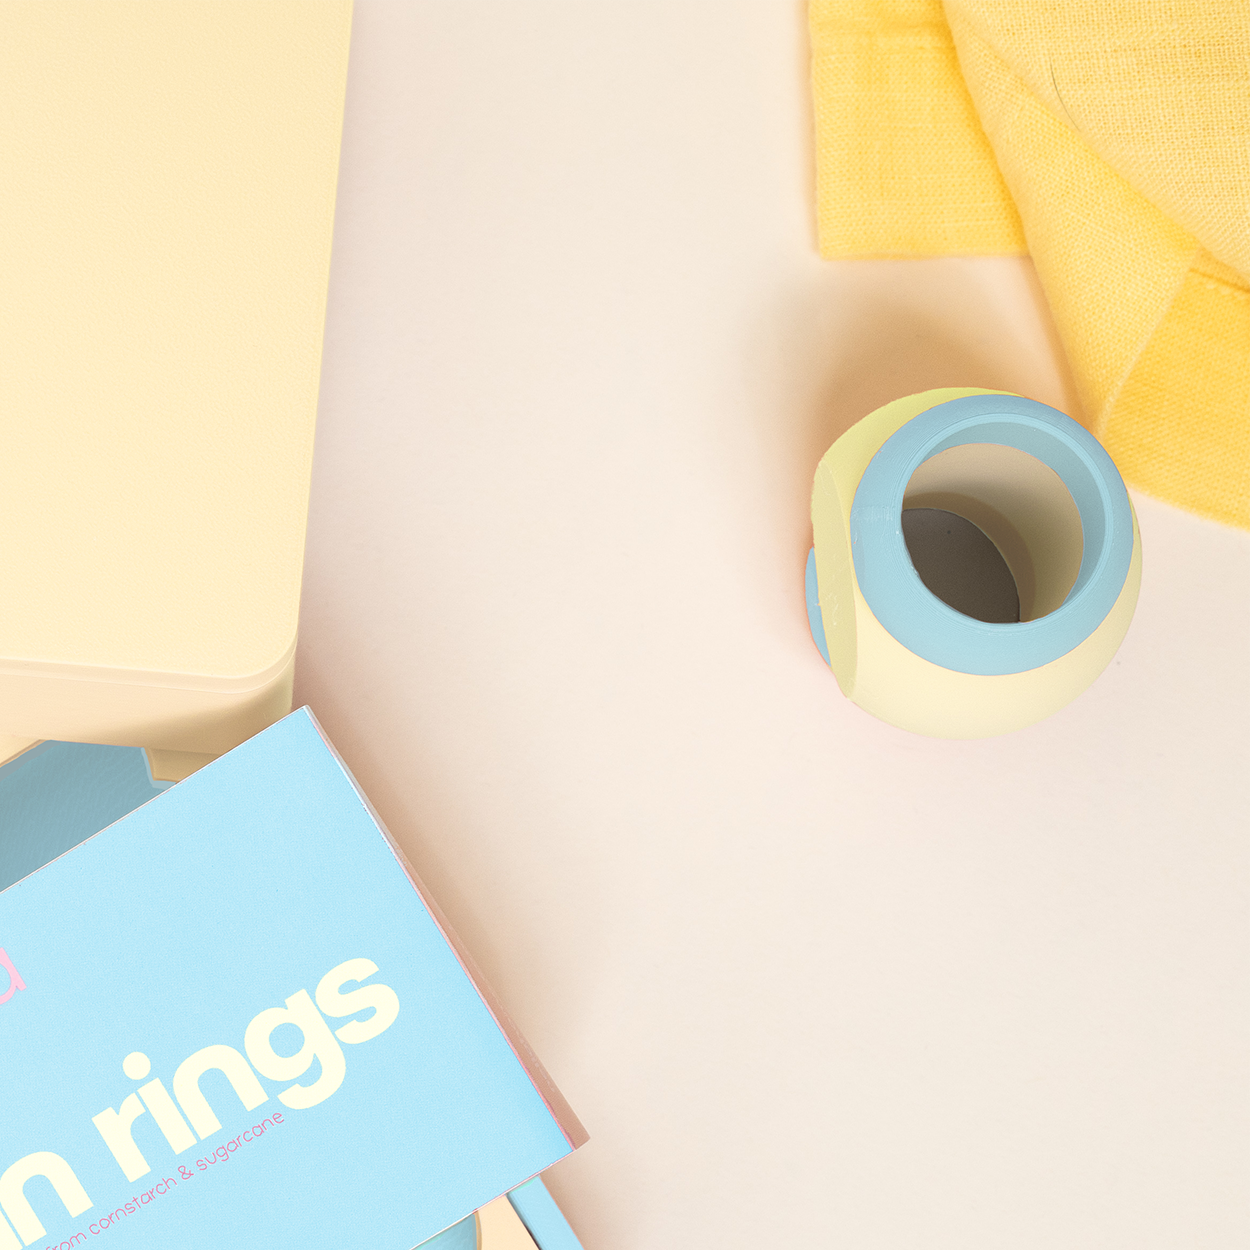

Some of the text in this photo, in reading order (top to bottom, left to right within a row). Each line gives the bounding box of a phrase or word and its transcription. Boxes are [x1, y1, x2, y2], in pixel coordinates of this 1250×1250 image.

[92, 957, 400, 1183] rings
[88, 1176, 178, 1236] cornstarch
[177, 1164, 194, 1181] &
[195, 1112, 285, 1172] sugarcane
